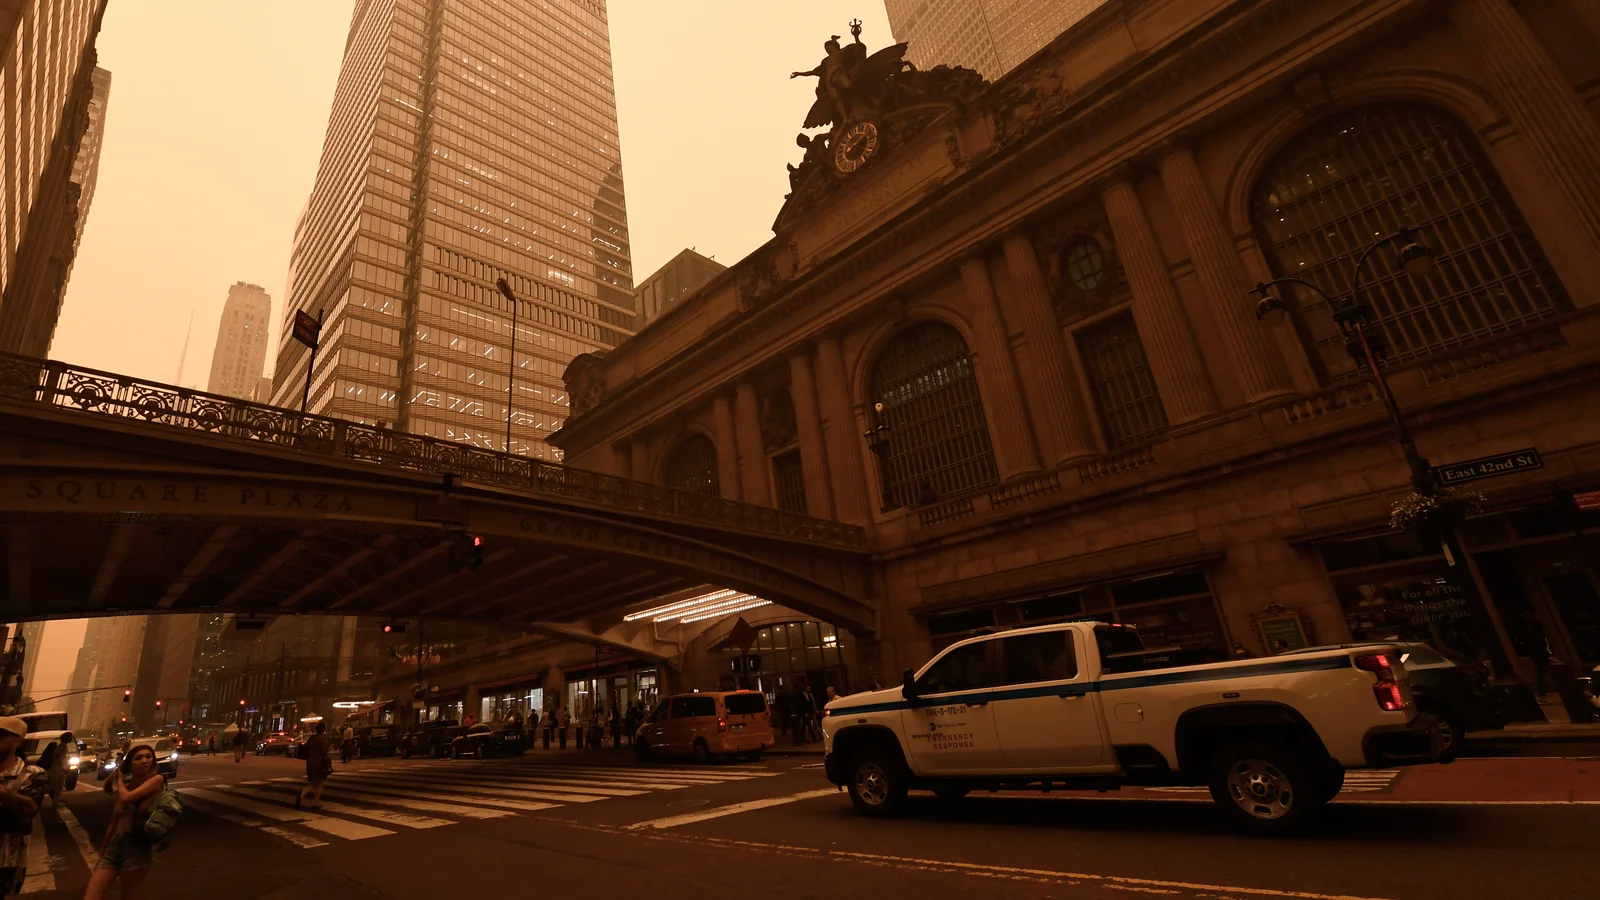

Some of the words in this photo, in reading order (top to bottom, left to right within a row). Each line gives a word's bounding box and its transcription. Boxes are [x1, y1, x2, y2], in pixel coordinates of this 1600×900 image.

[1446, 467, 1476, 481] East
[1479, 458, 1514, 473] 42nd
[1517, 455, 1535, 467] St
[26, 478, 209, 504] SQUARE
[240, 488, 354, 511] PLAZA
[519, 518, 599, 541] GRAND
[1401, 590, 1422, 600] For
[1426, 587, 1441, 597] all
[1404, 601, 1445, 612] things
[927, 732, 974, 743] EMERGENCY
[933, 741, 975, 750] RESPONSE
